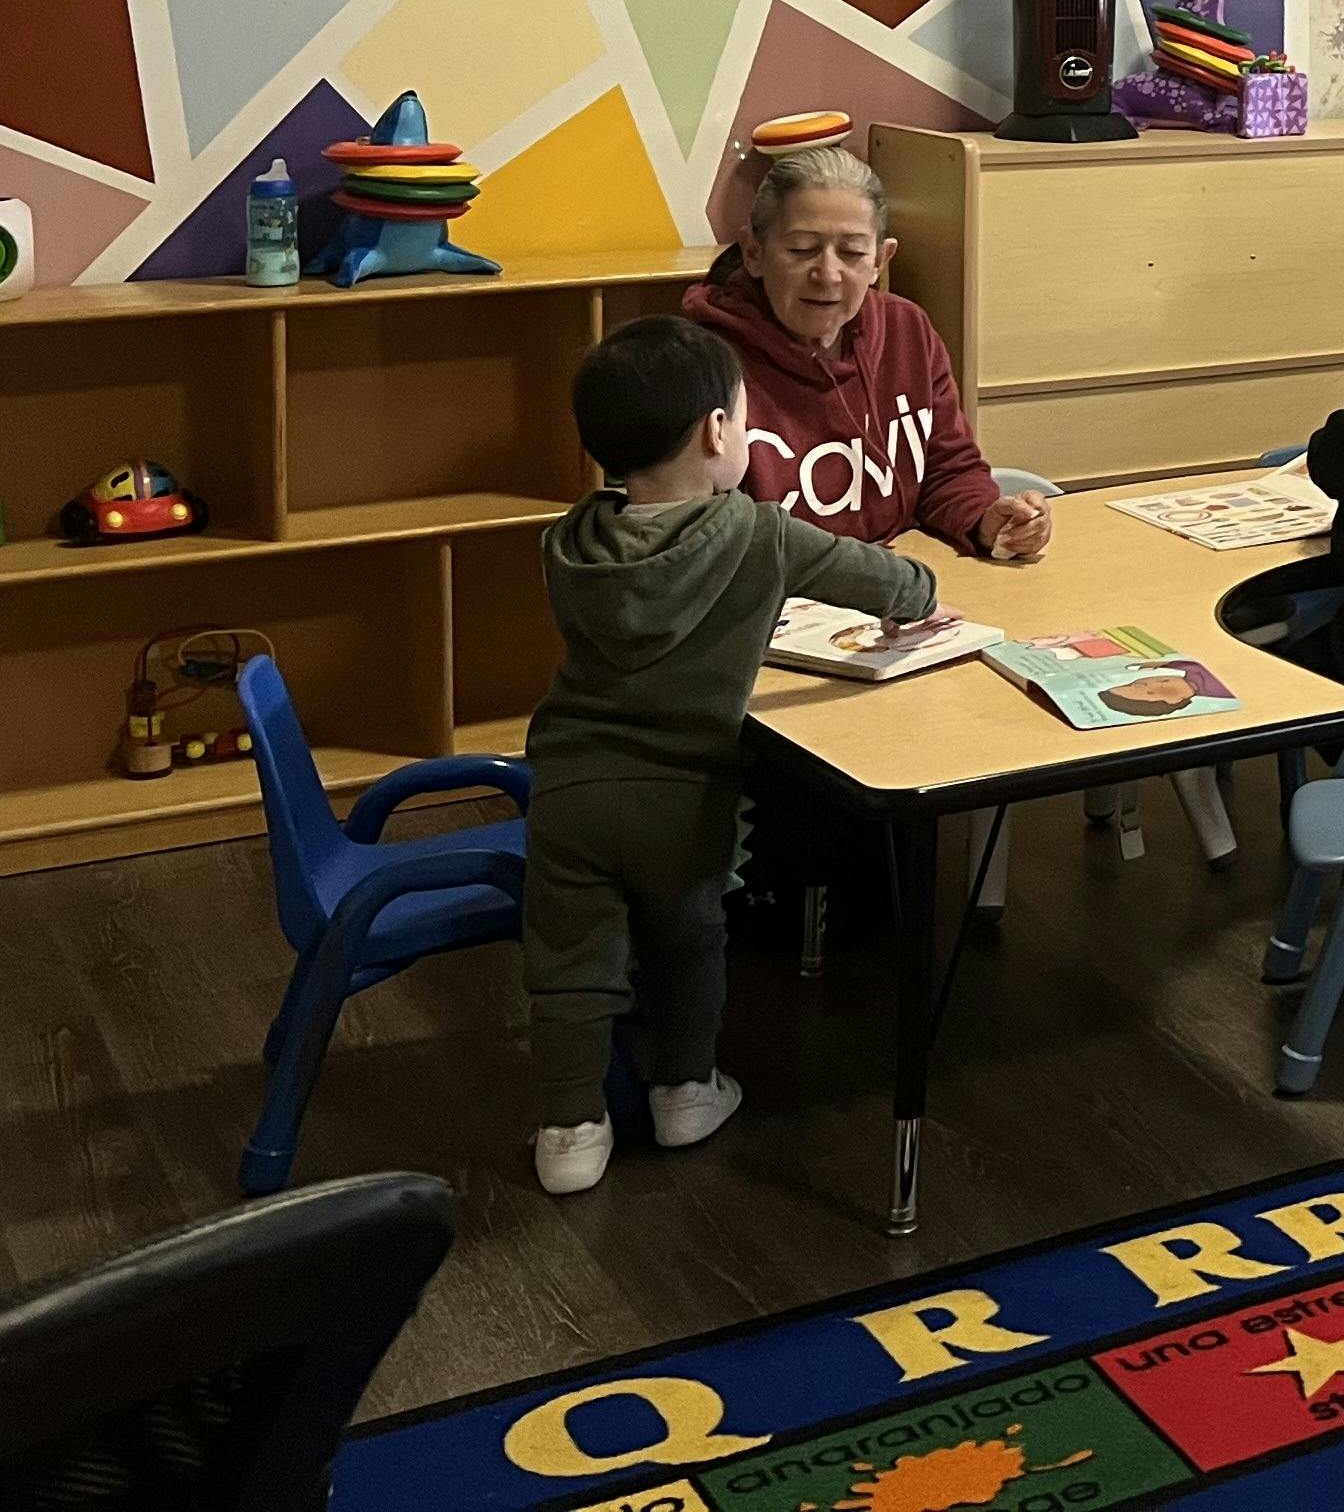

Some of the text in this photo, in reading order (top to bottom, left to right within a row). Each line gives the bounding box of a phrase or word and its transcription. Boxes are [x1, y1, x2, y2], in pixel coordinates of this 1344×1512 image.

[503, 1376, 773, 1478] Q
[850, 1287, 1050, 1382] R
[1114, 1328, 1230, 1373] una
[724, 1370, 1093, 1497] anaranjado
